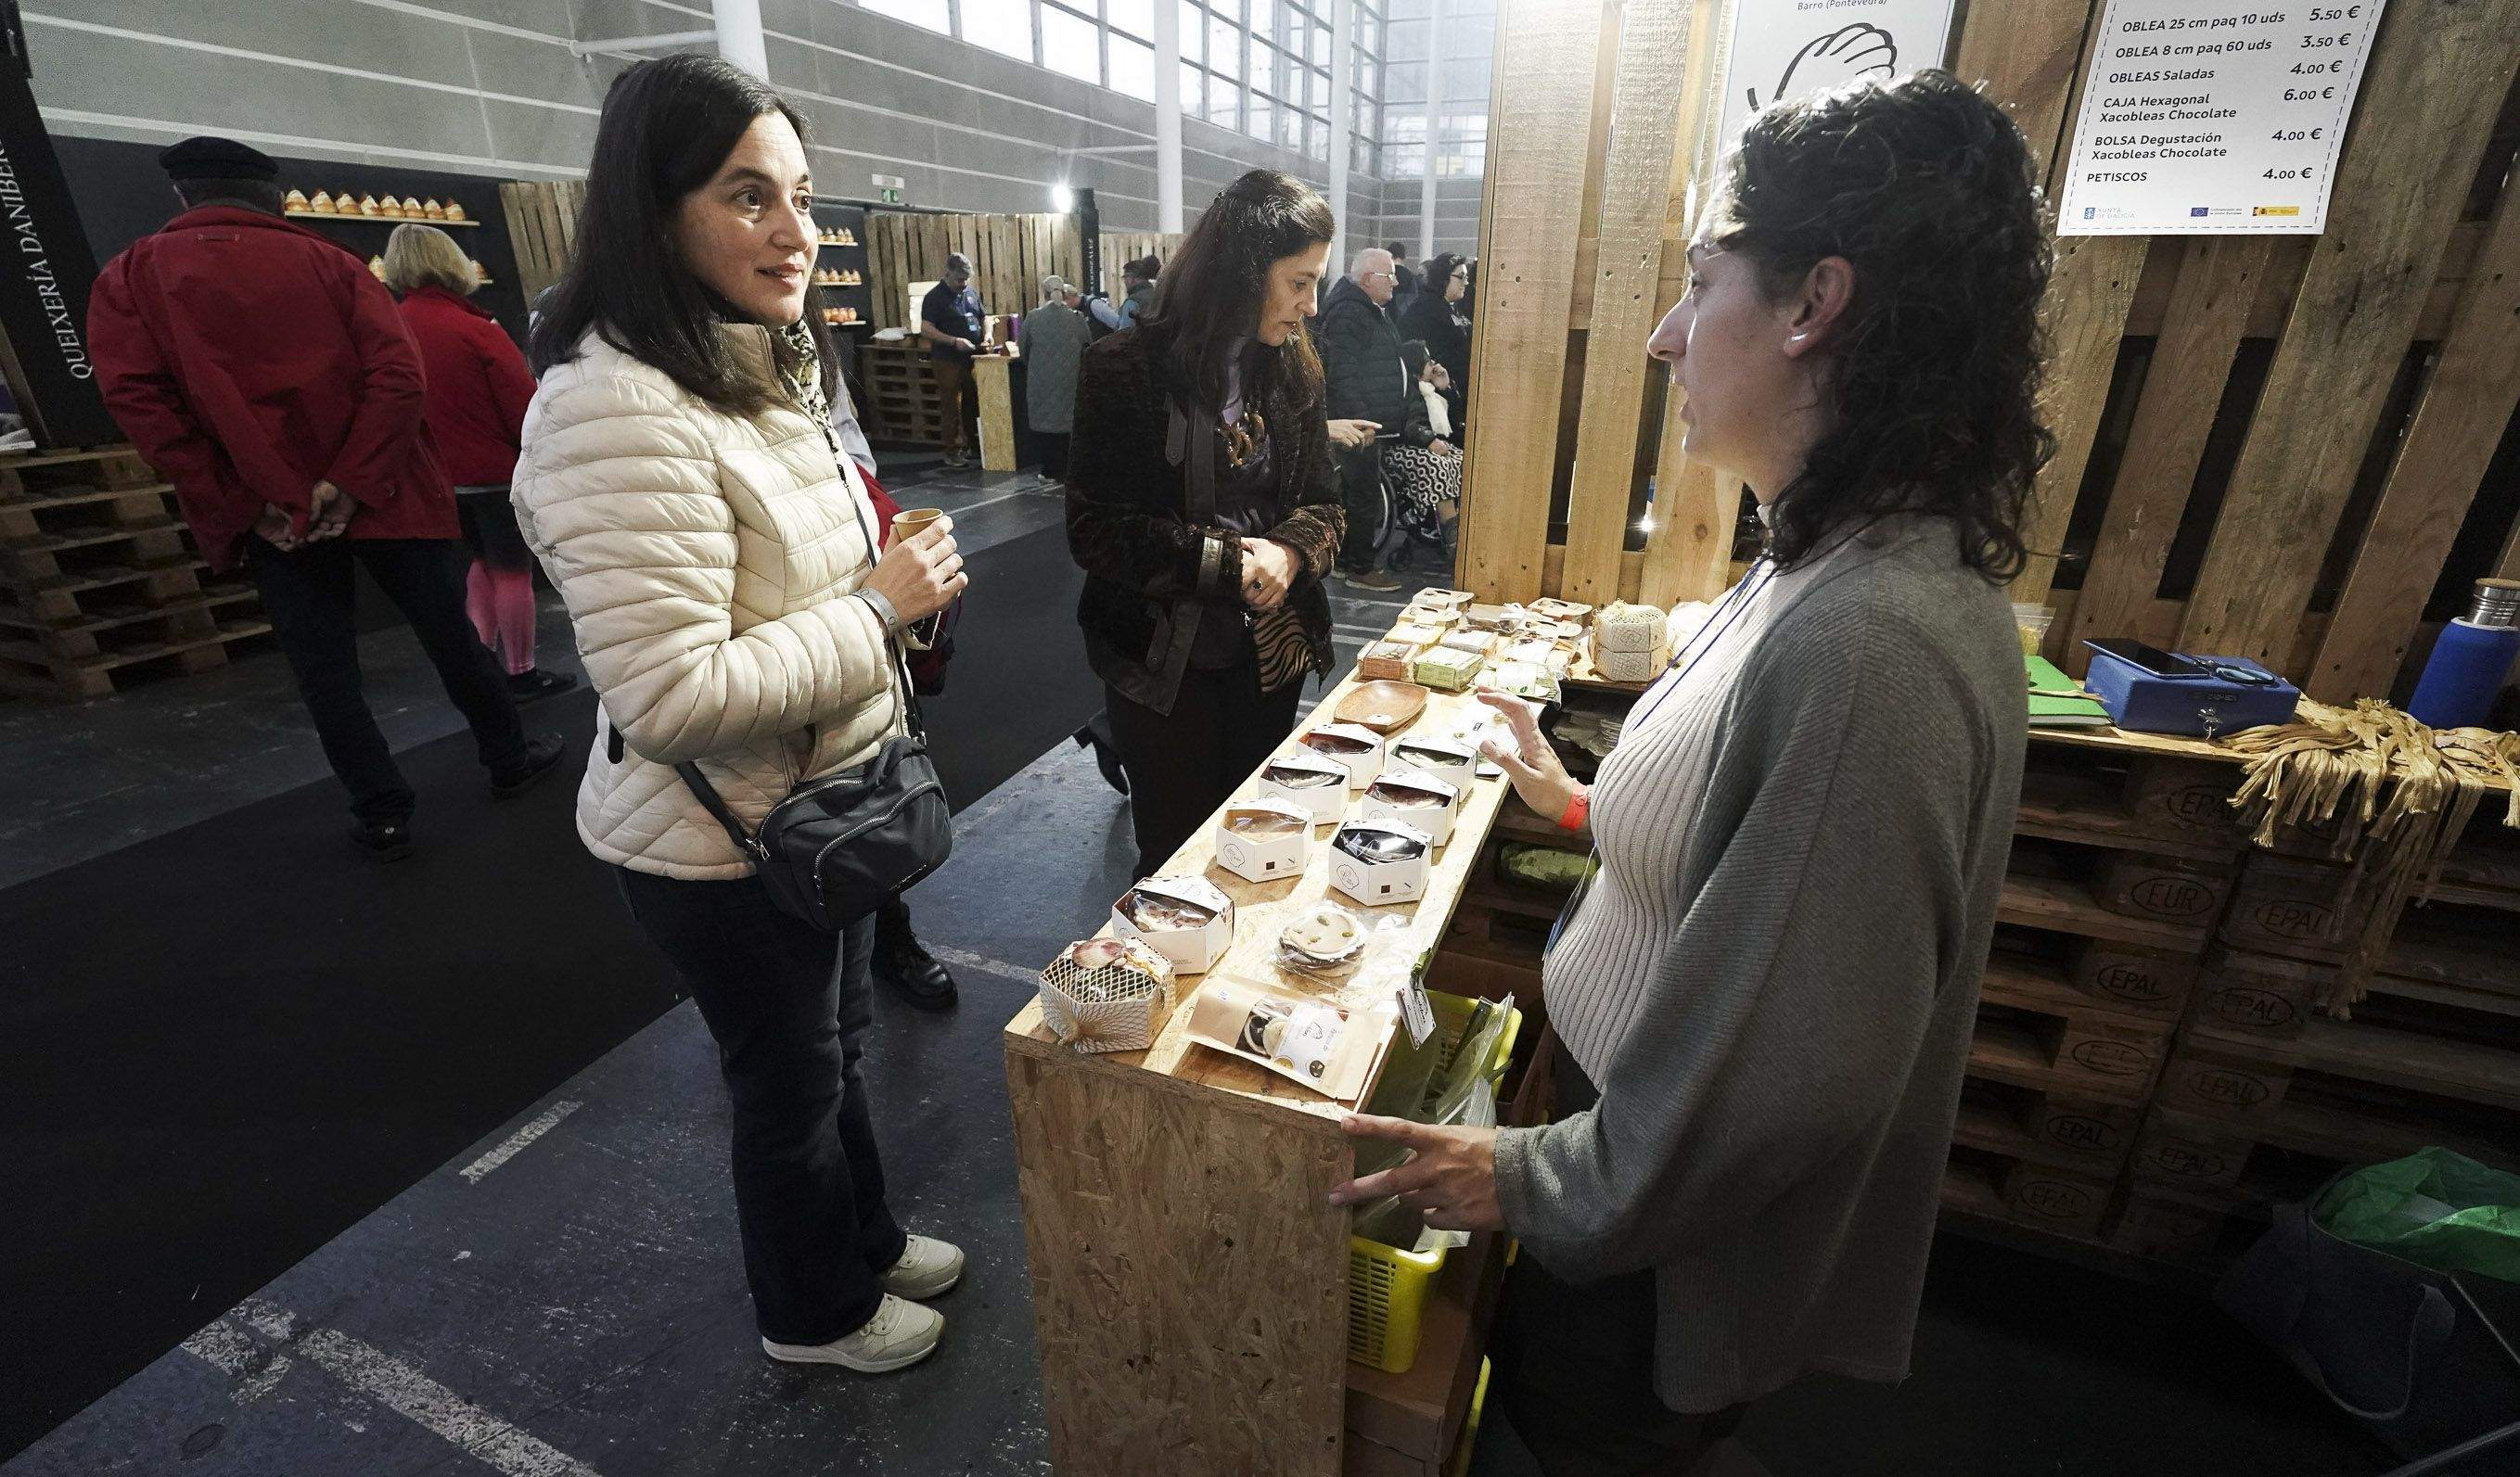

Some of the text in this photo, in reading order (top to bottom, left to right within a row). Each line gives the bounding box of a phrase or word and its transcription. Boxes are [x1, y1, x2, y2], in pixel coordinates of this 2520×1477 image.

[1797, 2, 1823, 10] Barro
[2123, 6, 2360, 32] OBLEA 25 cm paq 10 uds 5.50 €
[2116, 33, 2351, 57] OBLEA 8 cm paq 60 uds 3.50 €
[2110, 60, 2343, 83] OBLEAS Saladas 4.00 €
[2104, 87, 2335, 108] CAJA Hexagonal 6.00 €
[2100, 108, 2236, 122] Xacobleas Chocolate
[2095, 128, 2322, 146] BOLSA Degustación 4.00 €
[2092, 147, 2226, 159] Xacobleas Chocolate
[2088, 168, 2312, 182] PETISCOS 4.00 €
[27, 259, 93, 379] QUEIXERÍA
[2181, 791, 2228, 821] EPA
[2146, 883, 2199, 912] EUR
[2109, 968, 2160, 995] EPAL
[2059, 1118, 2104, 1145] EPAL
